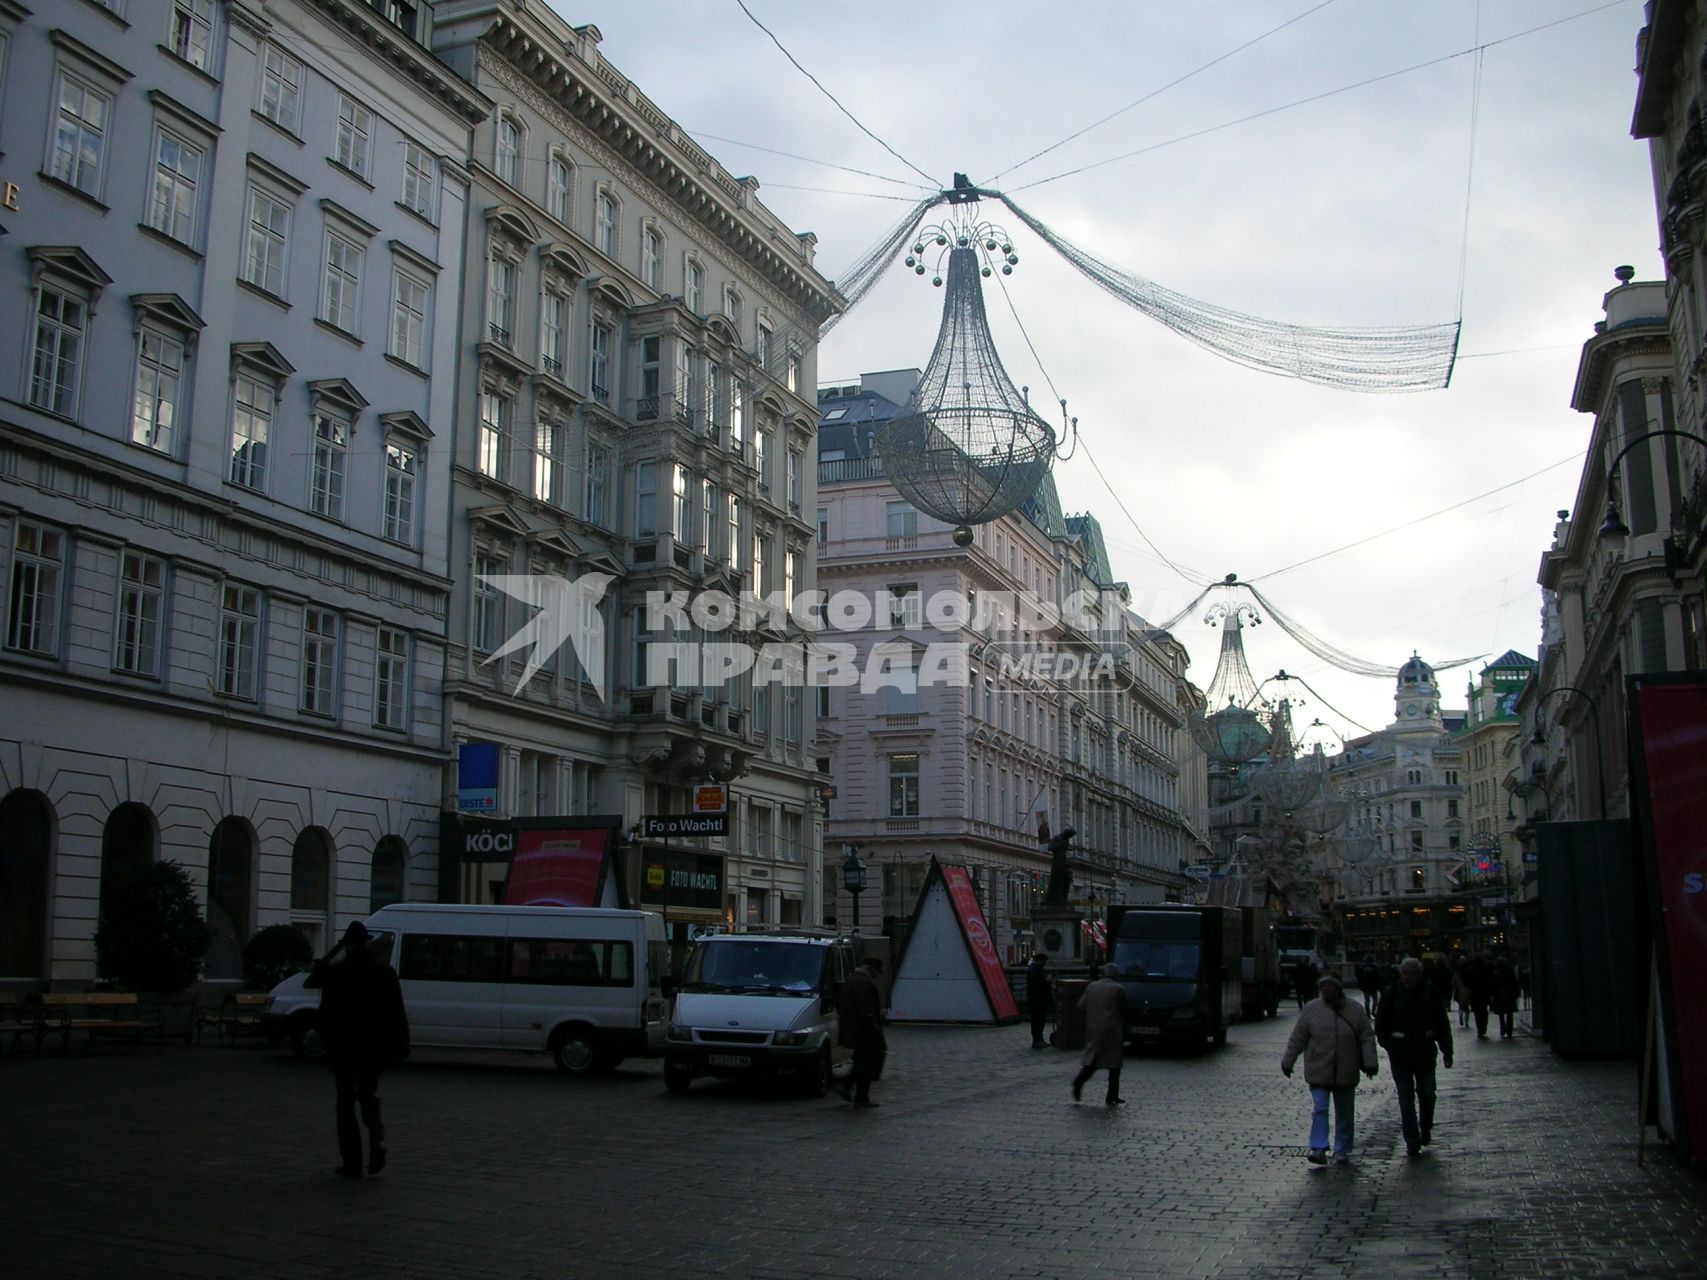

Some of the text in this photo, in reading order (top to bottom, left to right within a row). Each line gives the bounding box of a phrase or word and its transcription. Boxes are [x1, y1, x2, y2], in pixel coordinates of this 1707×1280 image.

[459, 798, 485, 809] ERSTE
[649, 818, 724, 832] Foo Wachtl
[670, 870, 689, 888] FOTO
[690, 871, 717, 890] WACHTL
[1682, 871, 1707, 895] S
